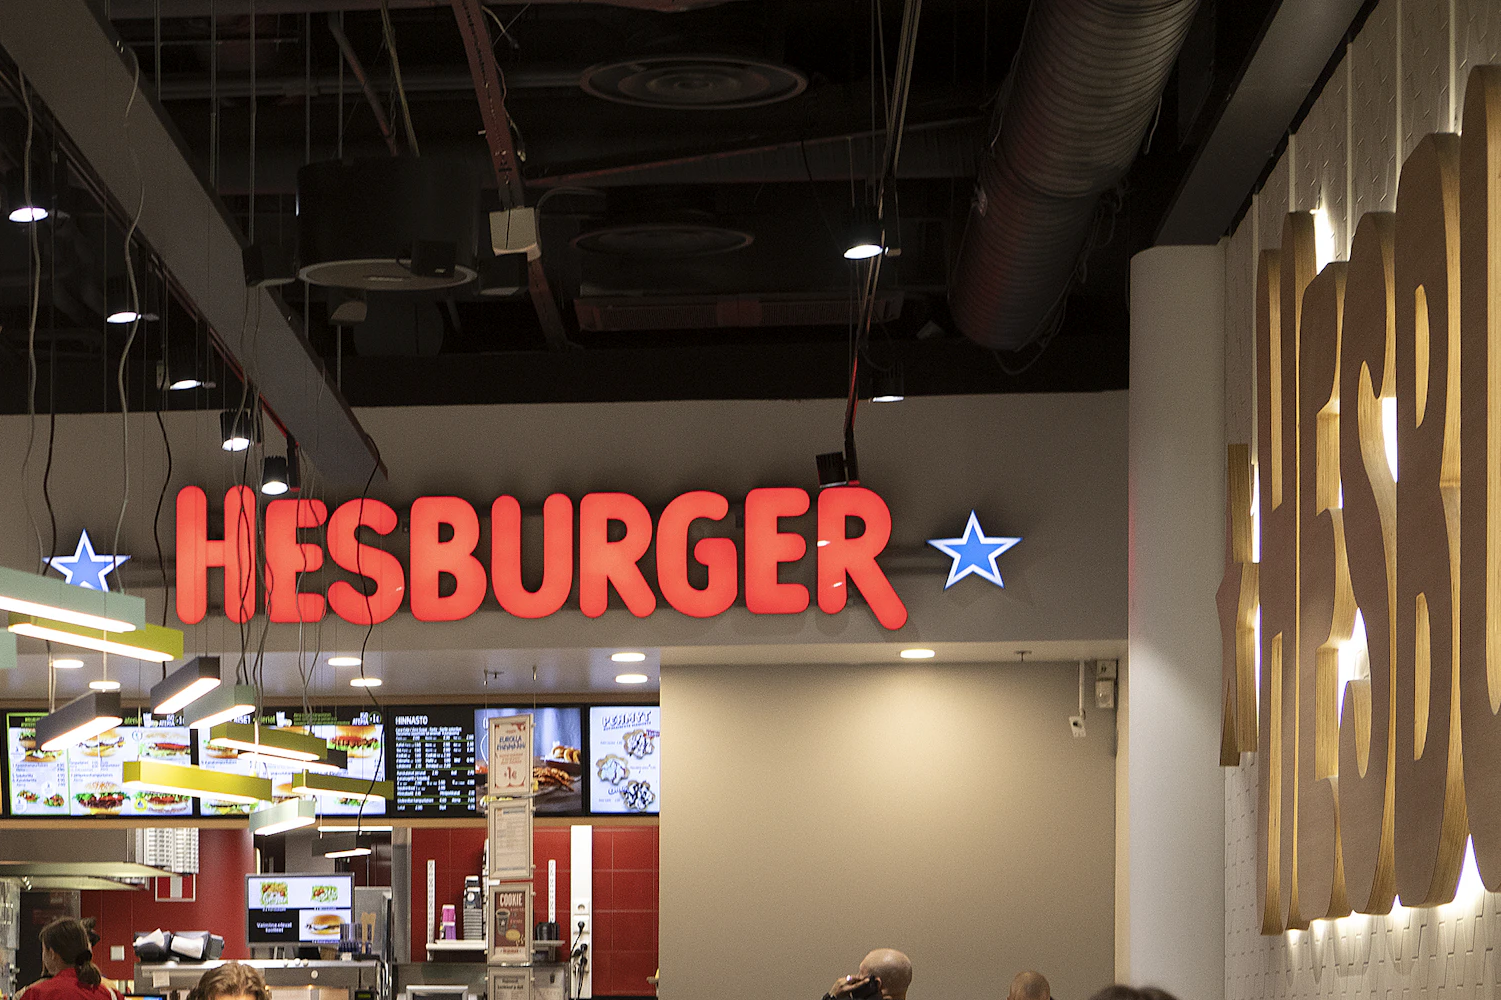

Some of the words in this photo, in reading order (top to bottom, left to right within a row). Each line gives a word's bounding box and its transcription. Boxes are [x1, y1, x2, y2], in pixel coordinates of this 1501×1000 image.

[175, 485, 908, 631] HESBURGER
[395, 715, 428, 726] HINNASTO
[499, 892, 523, 907] COOKIE
